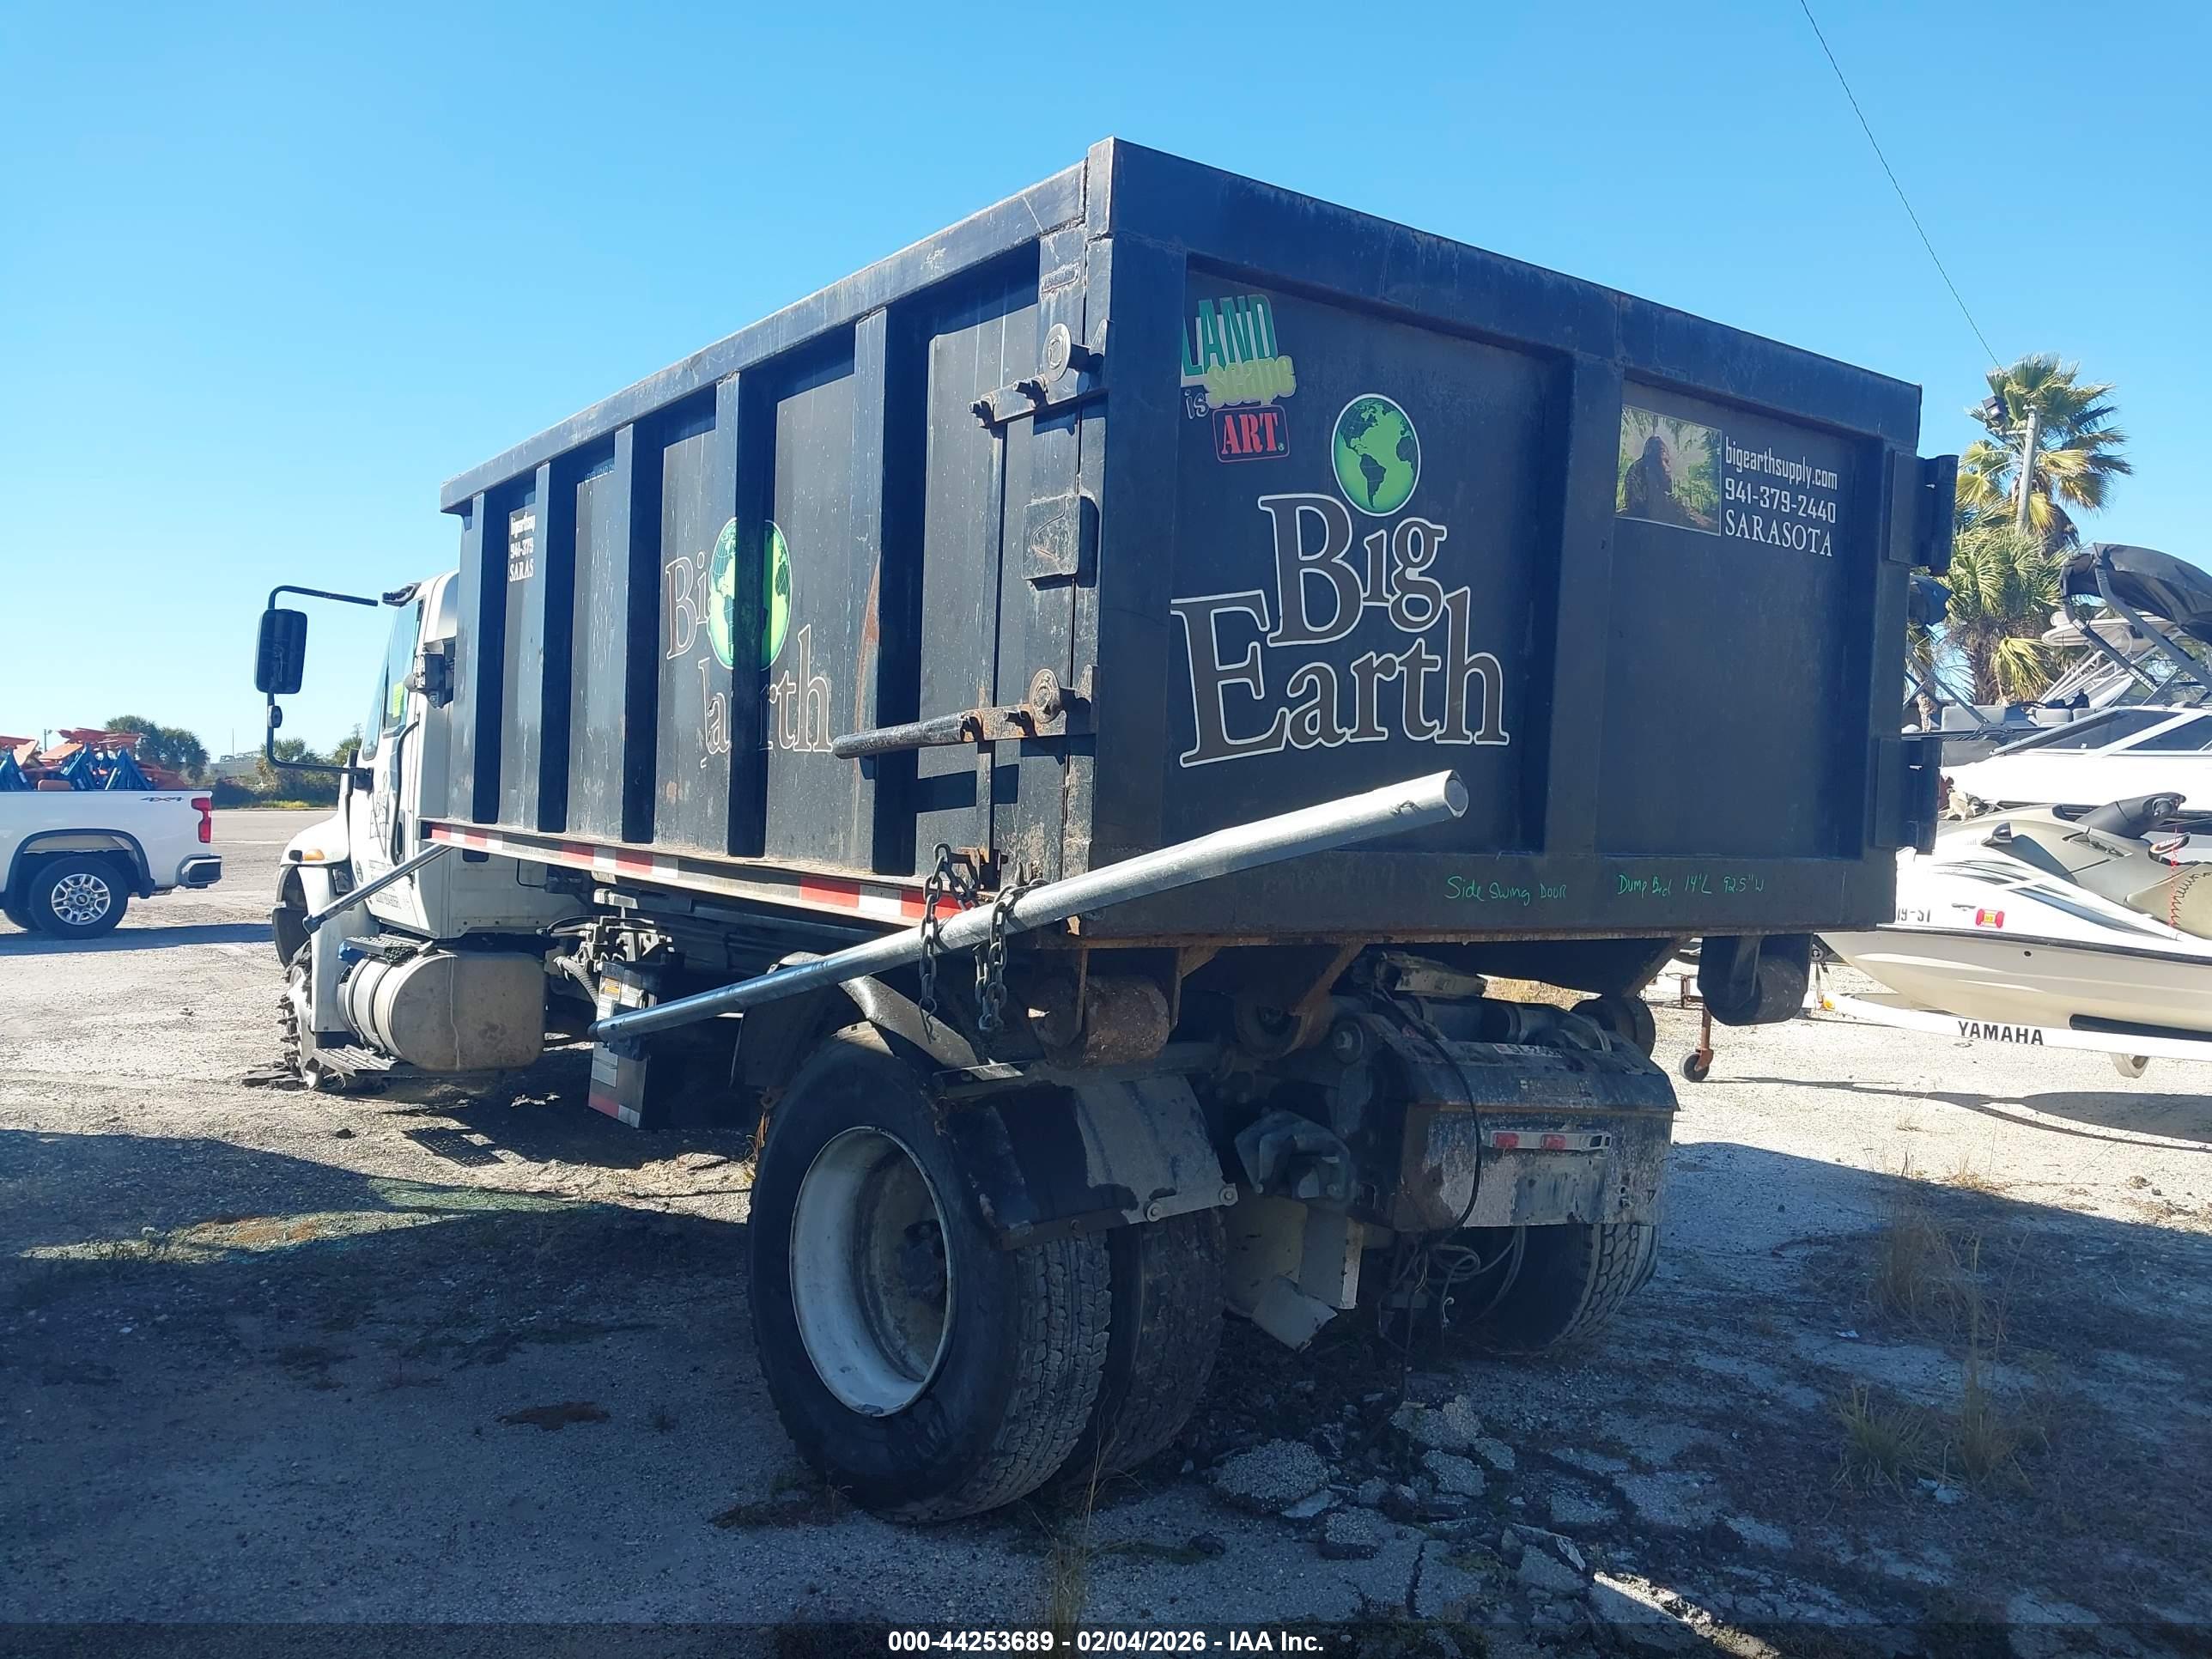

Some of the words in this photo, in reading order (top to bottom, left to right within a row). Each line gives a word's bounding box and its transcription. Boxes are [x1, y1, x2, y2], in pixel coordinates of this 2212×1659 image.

[1181, 295, 1278, 386] LAND
[1184, 389, 1211, 419] is
[1204, 356, 1297, 409] scape
[1725, 436, 1838, 491] bigearthsupply.com
[1724, 477, 1837, 524] 941-379-2440
[1725, 509, 1832, 557] SARASOTA
[1257, 493, 1448, 647] Big
[1170, 586, 1510, 768] Earth
[1444, 876, 1485, 902] Side
[1489, 882, 1530, 906] Swing
[1618, 874, 1647, 899] Dump
[1958, 1020, 2044, 1046] YAMAHA
